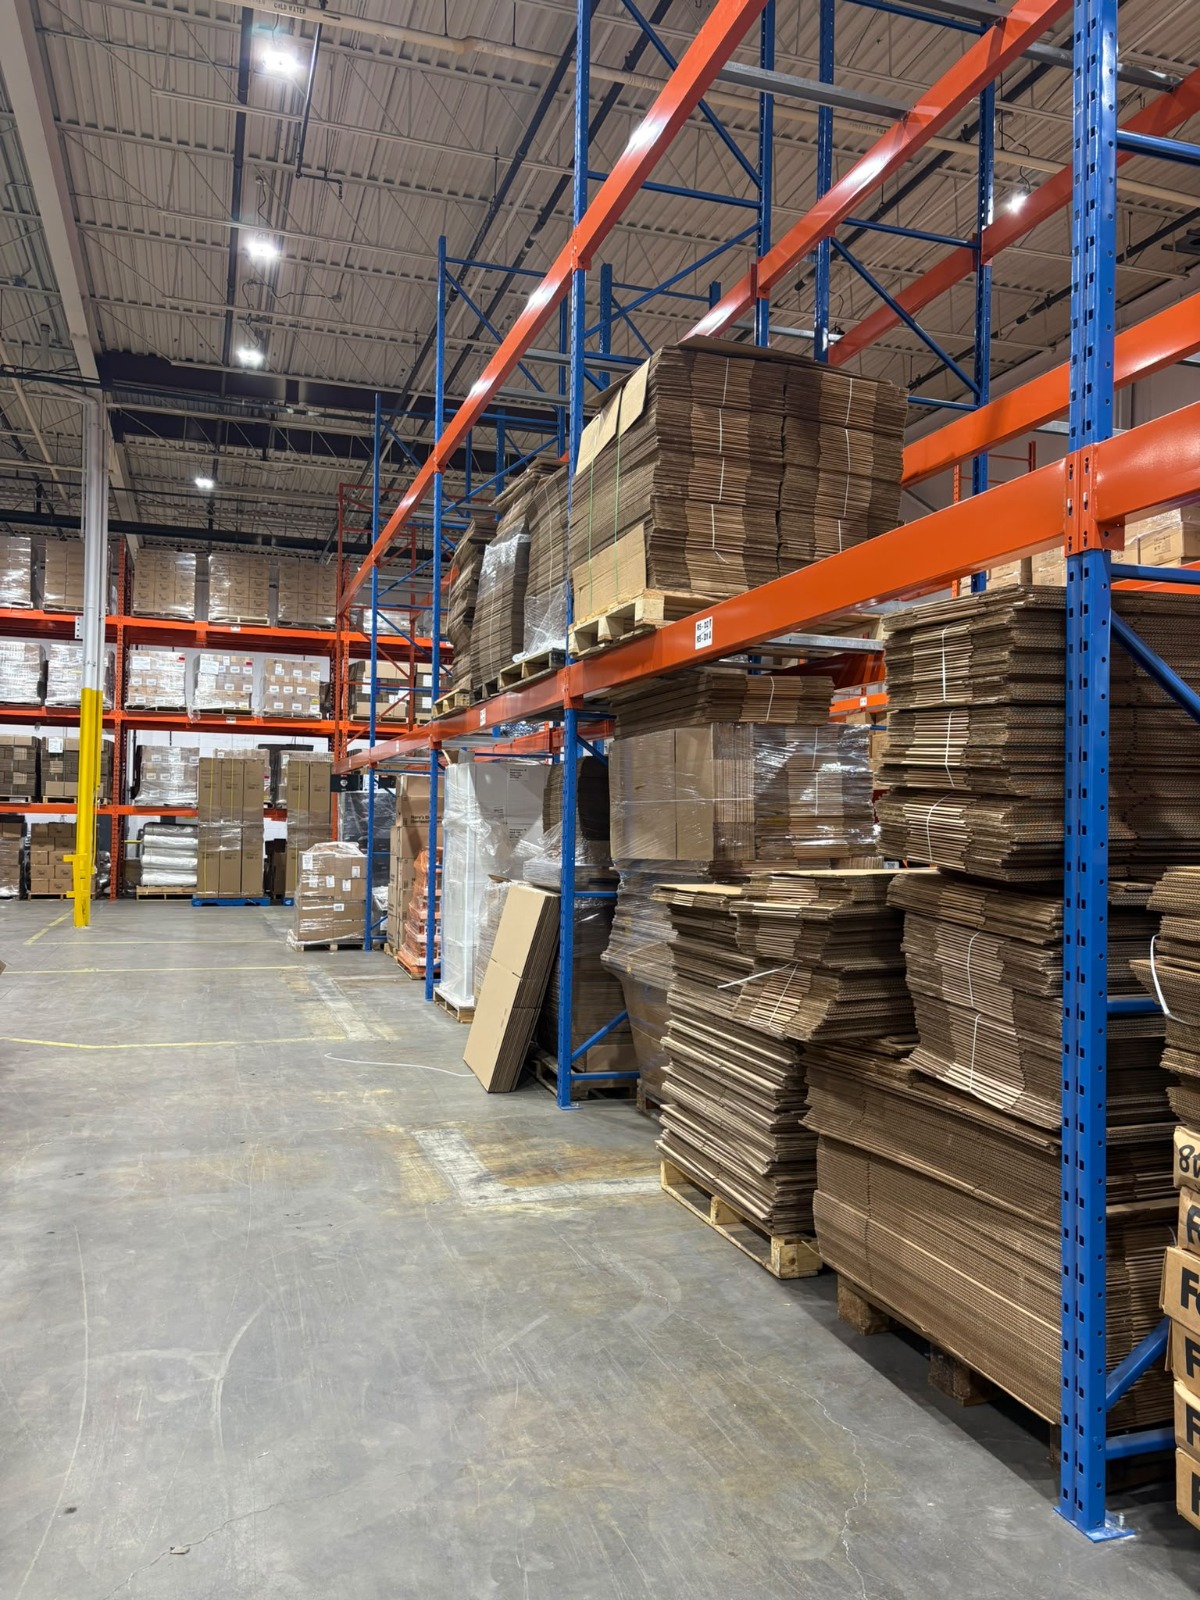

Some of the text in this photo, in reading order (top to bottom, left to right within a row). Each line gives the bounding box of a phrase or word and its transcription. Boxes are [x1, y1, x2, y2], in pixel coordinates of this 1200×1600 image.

[273, 2, 287, 11] COLD
[288, 5, 306, 14] WATER
[1180, 1266, 1200, 1317] F
